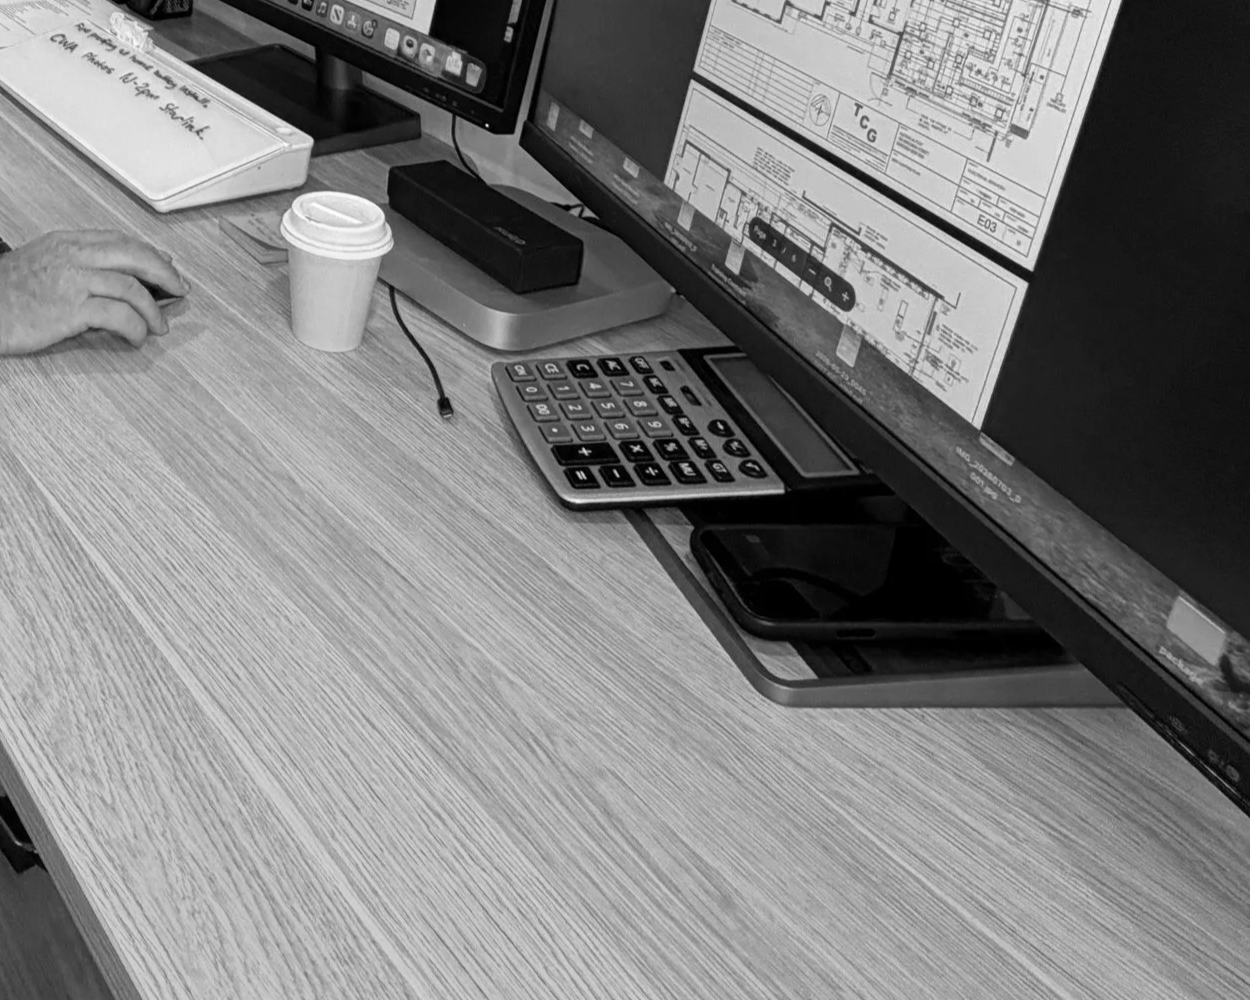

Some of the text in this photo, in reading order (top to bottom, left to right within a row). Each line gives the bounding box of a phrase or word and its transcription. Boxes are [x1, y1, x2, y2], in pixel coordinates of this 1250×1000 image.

[49, 33, 79, 53] CWA
[81, 51, 116, 75] Photos
[976, 213, 998, 234] E03
[544, 362, 560, 374] CE
[589, 382, 602, 390] 4
[568, 404, 583, 412] 2
[600, 402, 616, 411] 5
[633, 400, 648, 408] 8
[535, 403, 551, 416] 00
[614, 422, 629, 430] 6
[647, 420, 663, 428] 9
